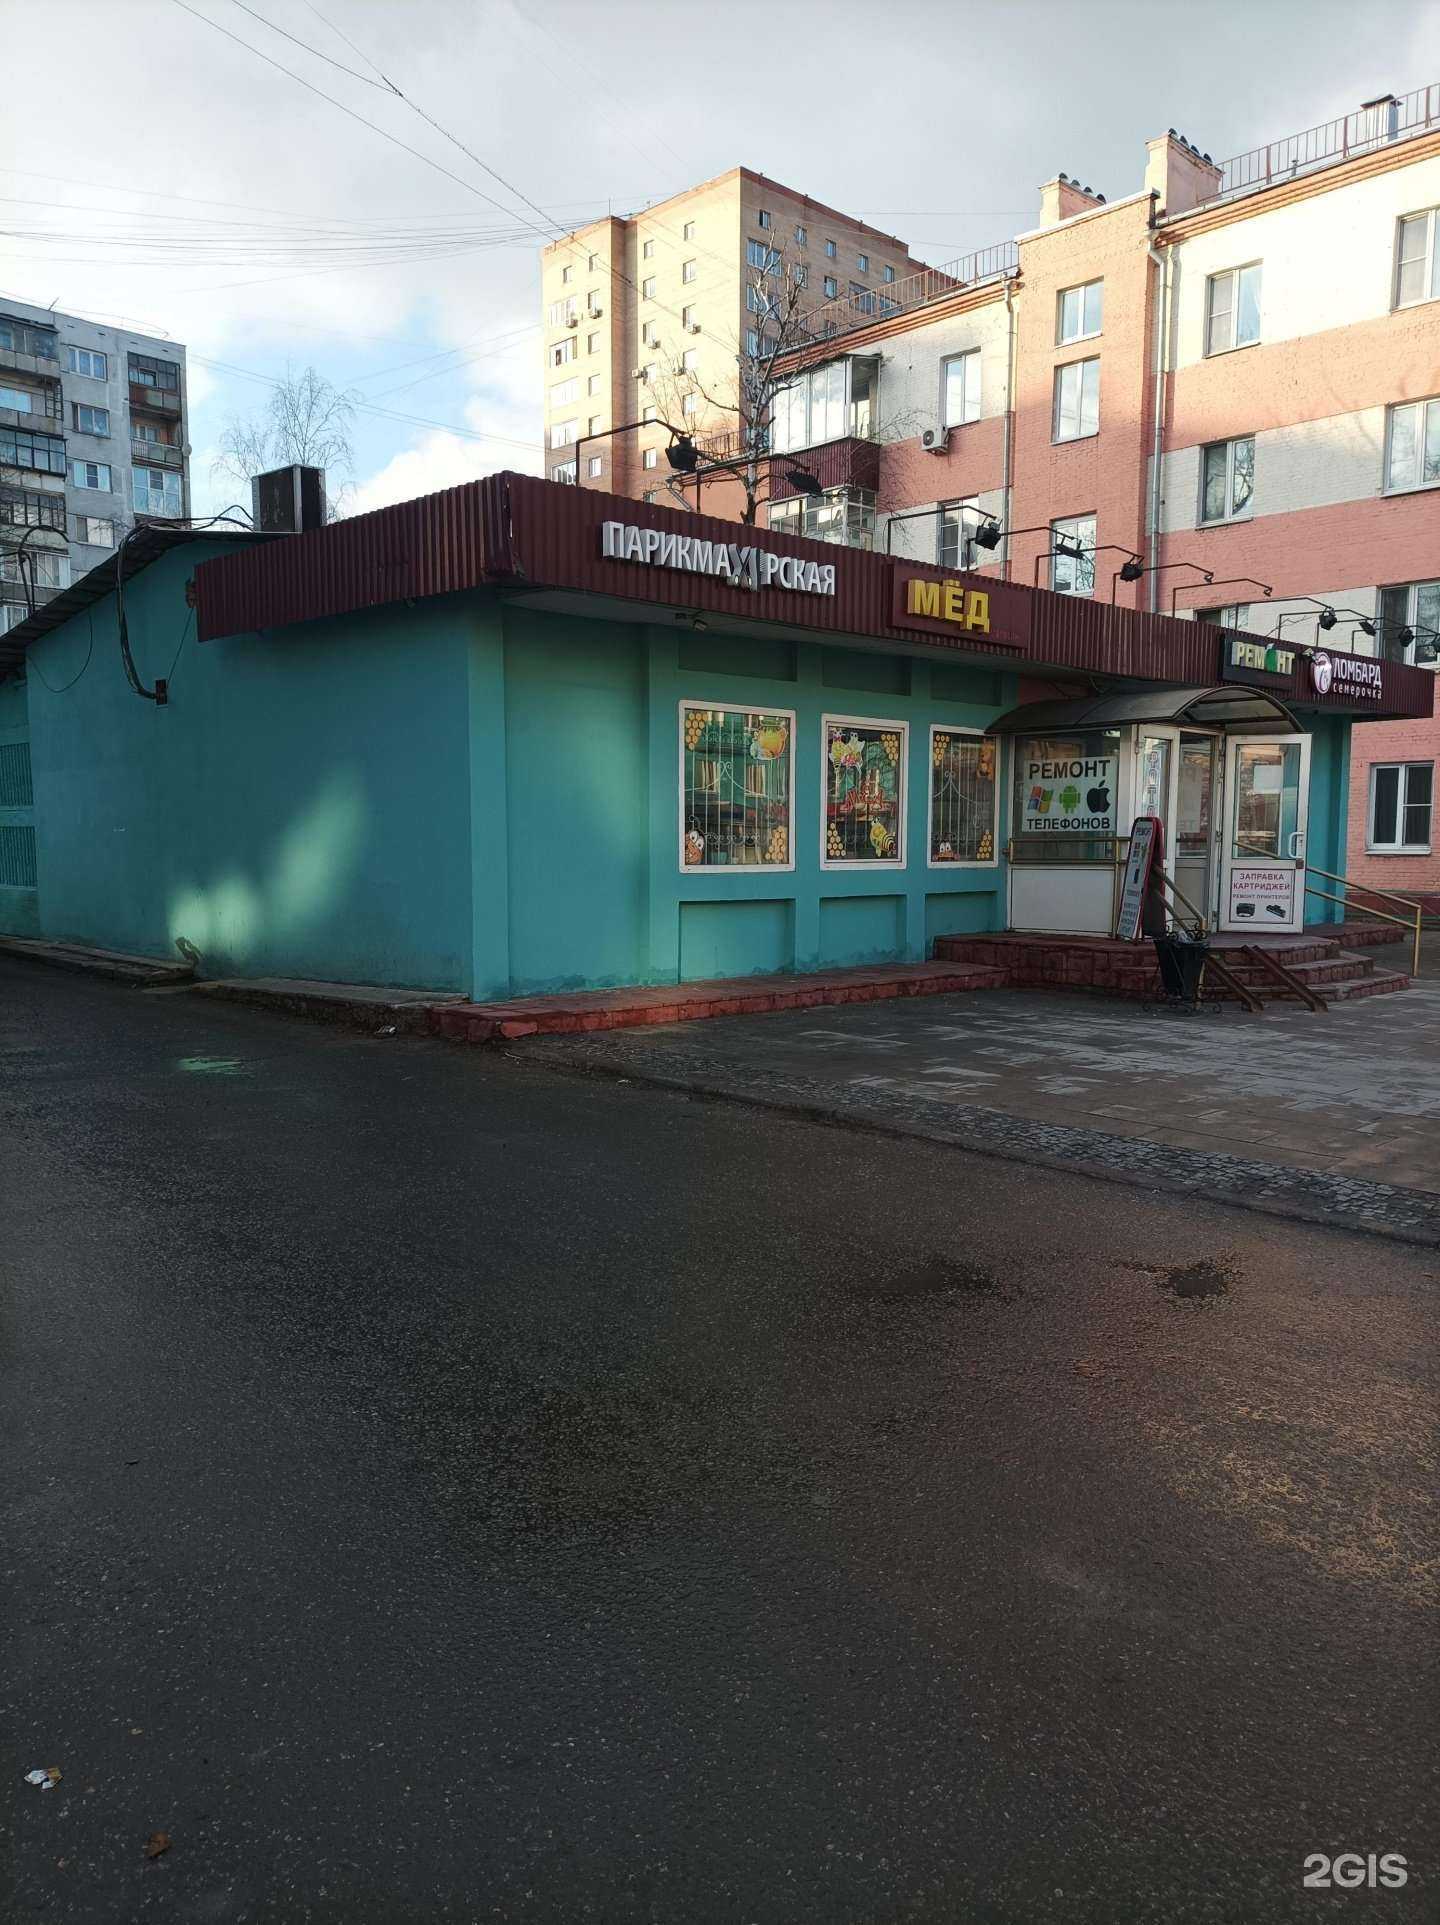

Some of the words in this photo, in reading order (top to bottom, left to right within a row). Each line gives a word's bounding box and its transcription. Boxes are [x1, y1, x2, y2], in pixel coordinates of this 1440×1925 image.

[907, 579, 991, 633] МЁД
[1332, 657, 1383, 689] ЛОМБАРД
[1028, 759, 1111, 780] РЕМОНТ
[1026, 817, 1111, 830] ТЕЛЕФОНОВ
[1239, 873, 1285, 881] ЗАПРАВКА
